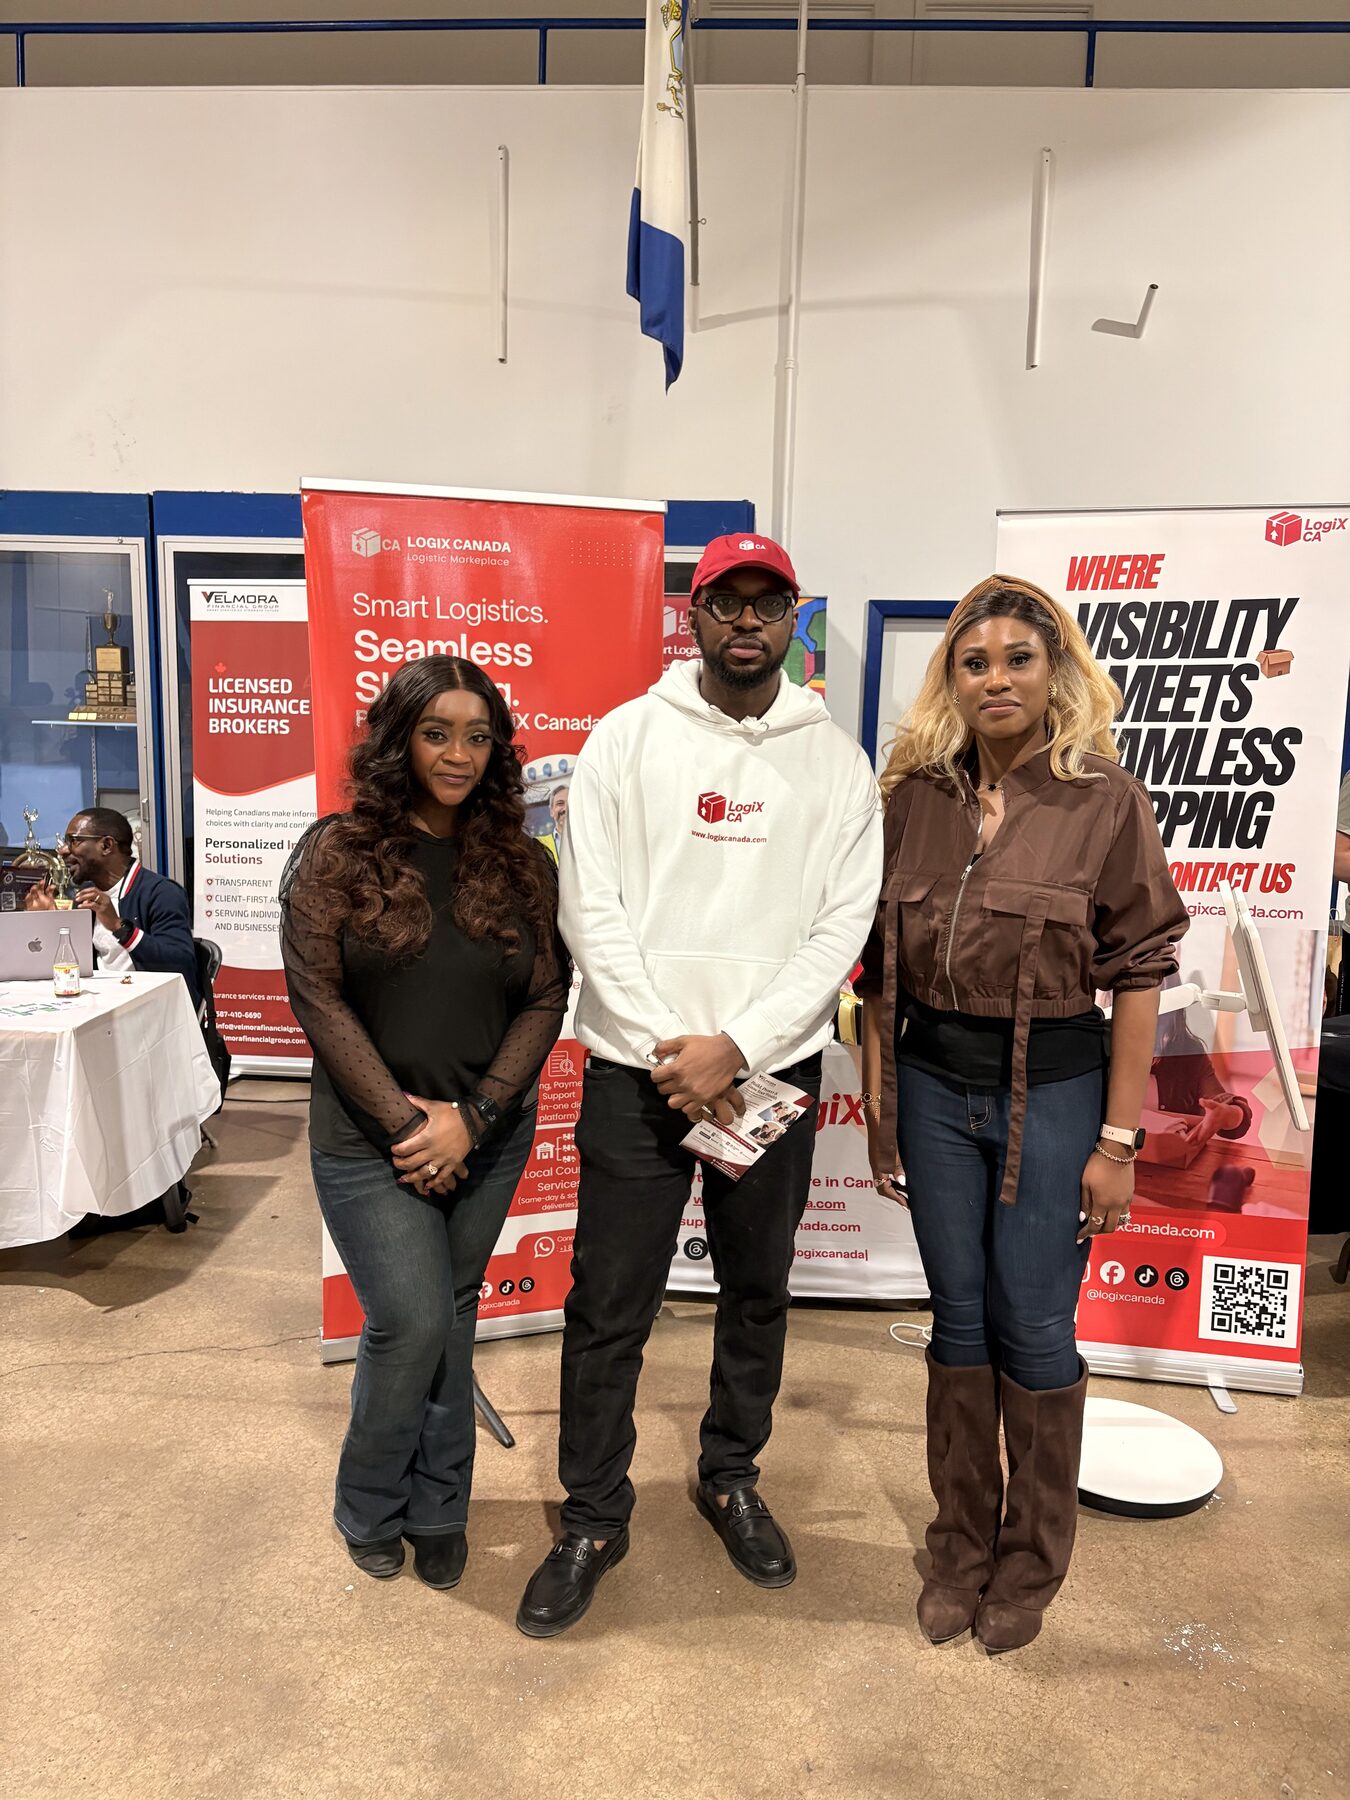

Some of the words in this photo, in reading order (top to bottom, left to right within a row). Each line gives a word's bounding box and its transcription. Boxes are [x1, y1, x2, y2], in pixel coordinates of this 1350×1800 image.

[1304, 518, 1348, 533] LogiX
[1302, 531, 1322, 542] CA
[382, 539, 400, 551] CA
[407, 536, 450, 549] LOGIX
[453, 538, 511, 552] CANADA
[407, 553, 447, 564] Logistic
[450, 555, 510, 567] Markeplace
[1066, 553, 1165, 591] WHERE
[201, 591, 279, 604] VELMORA
[353, 592, 429, 619] Smart
[436, 596, 549, 627] Logistics.
[1077, 597, 1300, 660] VISIBILITY
[354, 629, 534, 667] Seamless
[673, 645, 701, 657] Logis
[209, 678, 293, 694] LICENSED
[1105, 663, 1260, 723] MEETS
[209, 698, 310, 715] INSURANCE
[209, 718, 290, 734] BROKERS
[1111, 727, 1303, 787] AMLESS
[206, 808, 233, 817] Helping
[233, 809, 270, 817] Canadians
[728, 801, 765, 815] LogiX
[727, 813, 742, 823] CA
[1150, 790, 1275, 849] PPING
[251, 821, 273, 829] clarity
[691, 830, 767, 843] www.logixcanada.com
[205, 838, 284, 850] Personalized
[205, 853, 263, 865] Solutions
[215, 879, 272, 887] TRANSPARENT
[1168, 861, 1259, 893] ONTACT
[1259, 863, 1296, 894] US
[215, 895, 268, 903] CLIENT-FIRST
[215, 910, 249, 918] SERVING
[266, 994, 289, 1002] arrang
[216, 1023, 304, 1033] info@velmorafinancialgrou
[223, 1035, 306, 1044] lmorafinancialgroup.com
[542, 1092, 576, 1101] Support
[539, 1111, 579, 1124] platform)
[524, 1167, 553, 1179] Local
[826, 1177, 839, 1187] in
[518, 1194, 558, 1205] (Same-day
[541, 1200, 578, 1211] deliveries)
[1086, 1289, 1165, 1305] @logixcanada
[478, 1299, 520, 1311] ogixcanada
